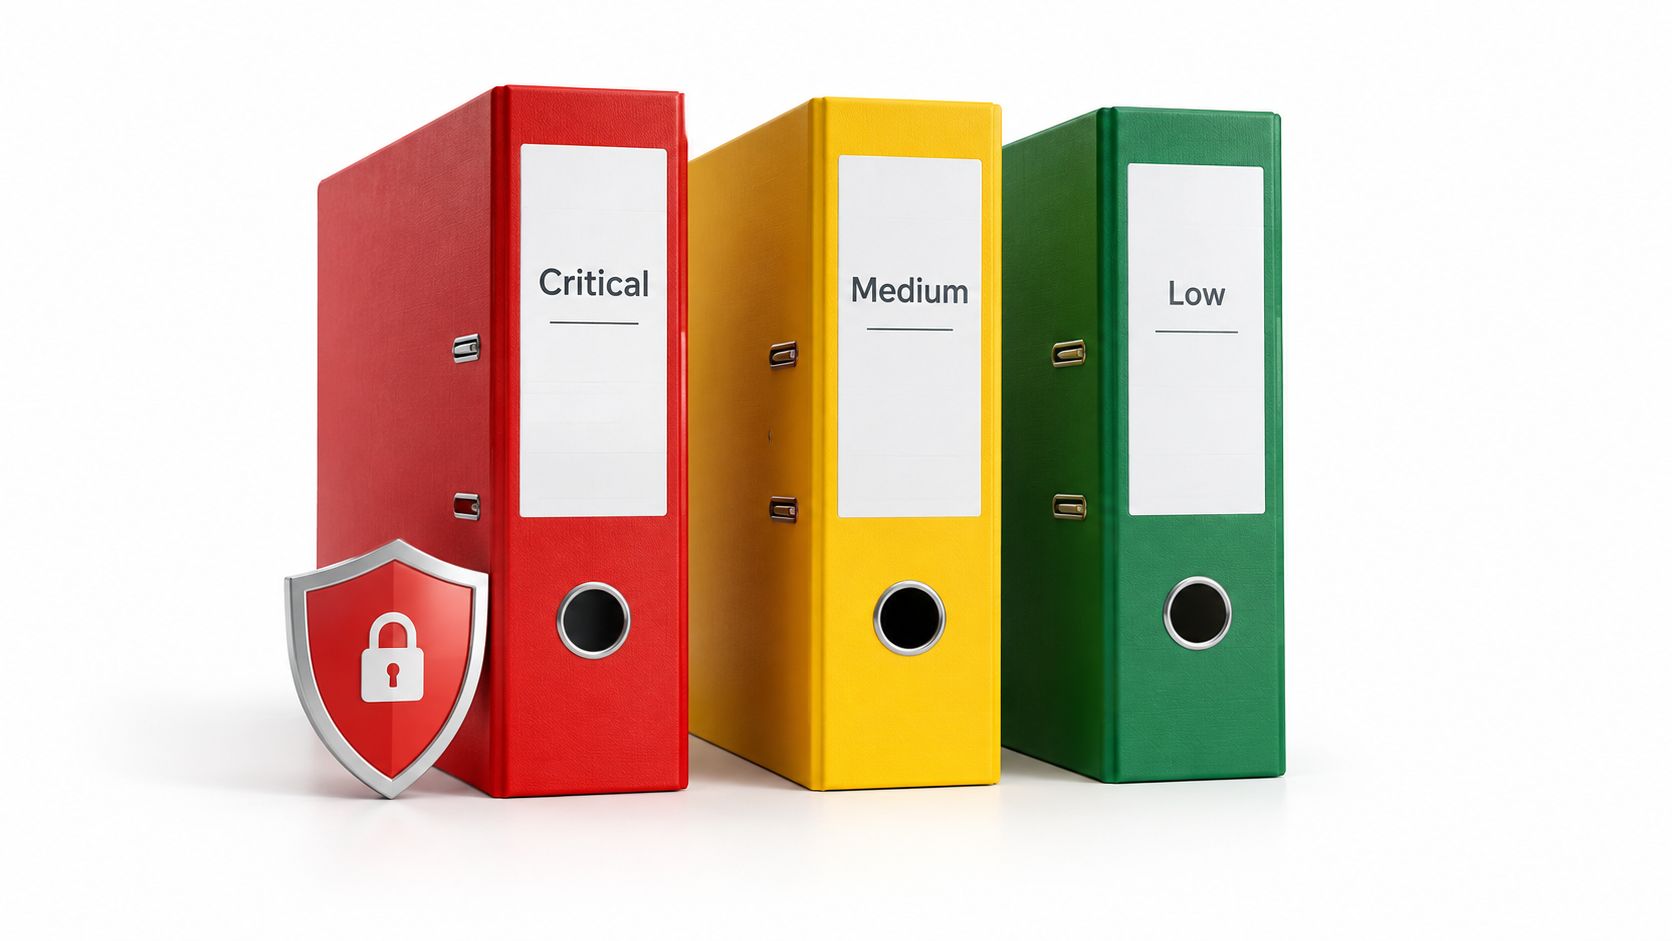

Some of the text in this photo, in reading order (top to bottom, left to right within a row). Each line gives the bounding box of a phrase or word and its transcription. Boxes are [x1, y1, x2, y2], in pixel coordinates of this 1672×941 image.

[539, 267, 649, 297] Critical
[852, 276, 968, 304] Medium
[1169, 280, 1226, 306] Low
